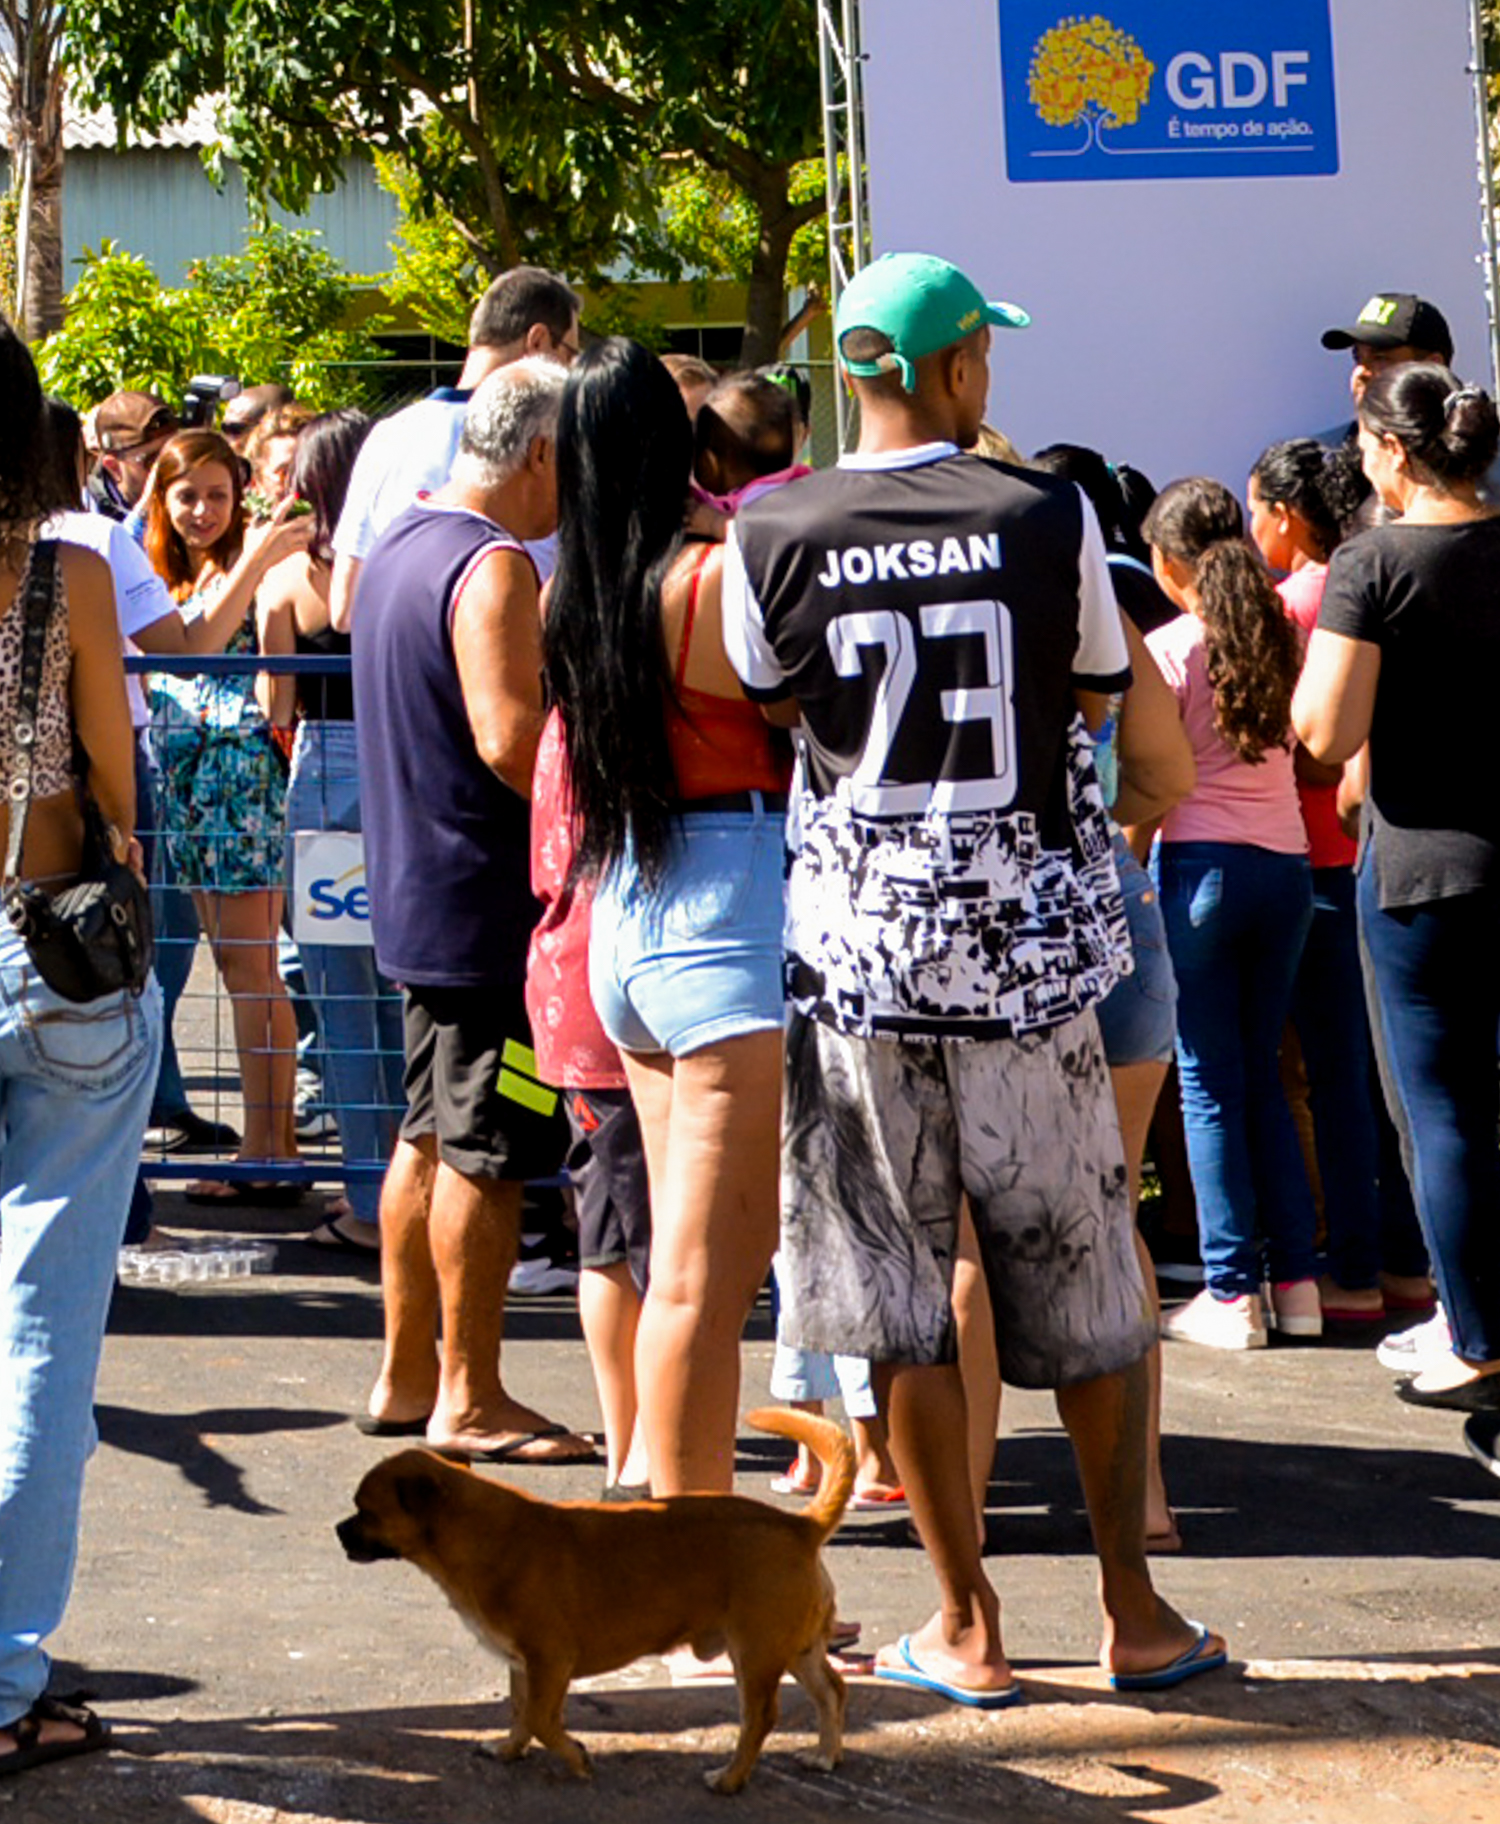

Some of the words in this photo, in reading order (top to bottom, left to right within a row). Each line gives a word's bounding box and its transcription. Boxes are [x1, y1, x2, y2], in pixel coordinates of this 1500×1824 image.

[1163, 51, 1310, 110] GDF
[1168, 116, 1181, 138] É
[1183, 123, 1240, 142] tempo
[1242, 122, 1264, 137] de
[1267, 122, 1313, 140] ação.
[817, 533, 1002, 589] JOKSAN
[826, 599, 1018, 817] 23
